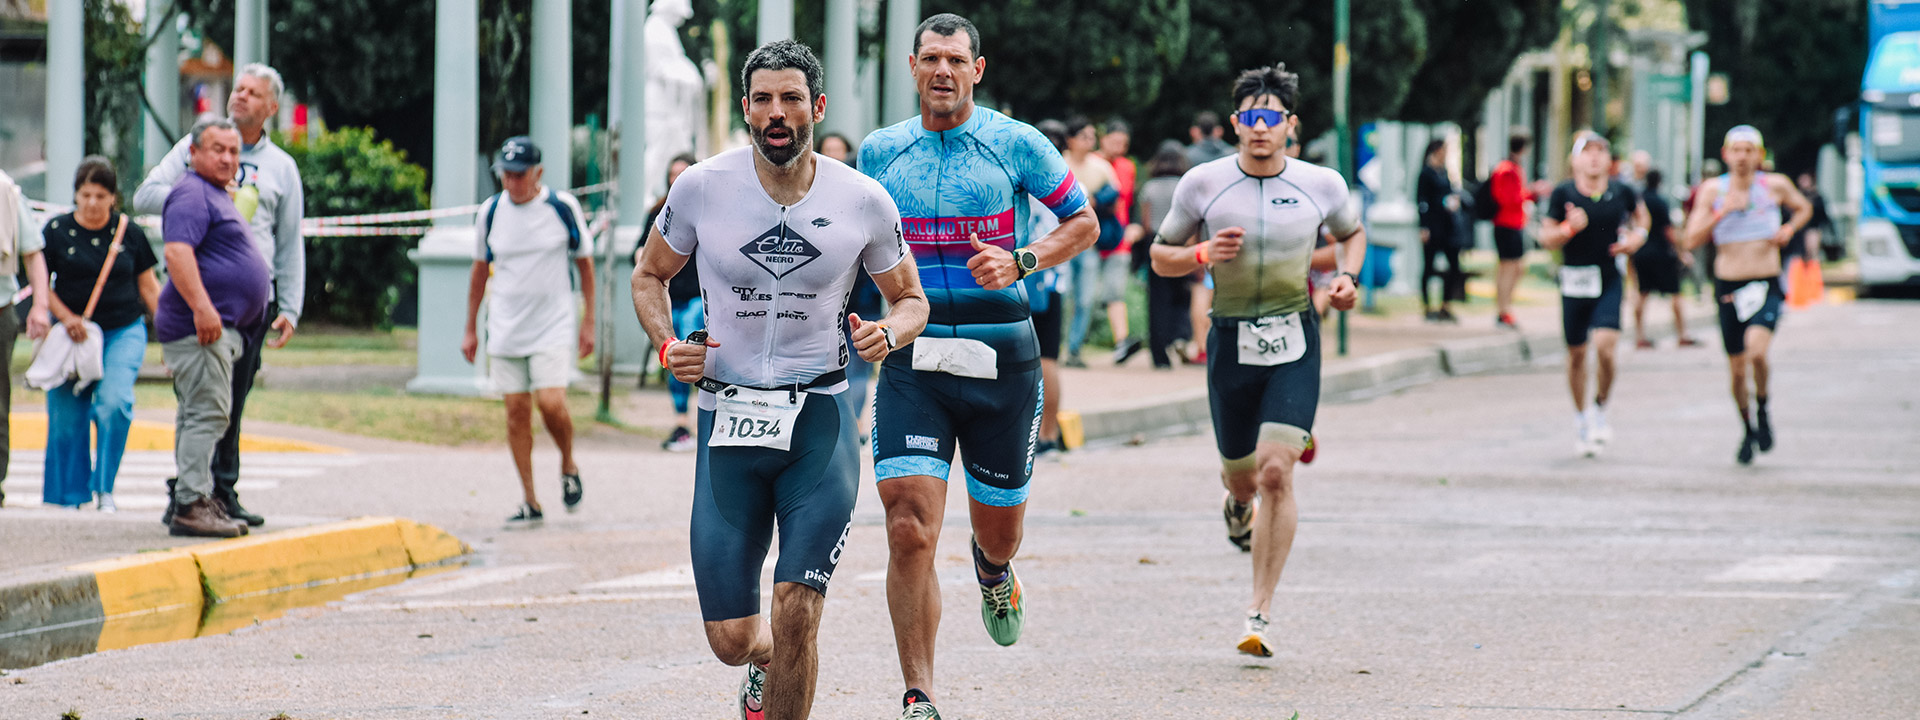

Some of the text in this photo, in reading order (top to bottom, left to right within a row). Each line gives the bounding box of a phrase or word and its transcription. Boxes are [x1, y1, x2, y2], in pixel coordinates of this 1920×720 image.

[902, 221, 956, 236] PALOMO
[958, 218, 999, 235] TEAM
[731, 286, 757, 296] CITY
[740, 293, 773, 302] BIKES
[1257, 336, 1288, 354] 961
[728, 416, 781, 438] 1034
